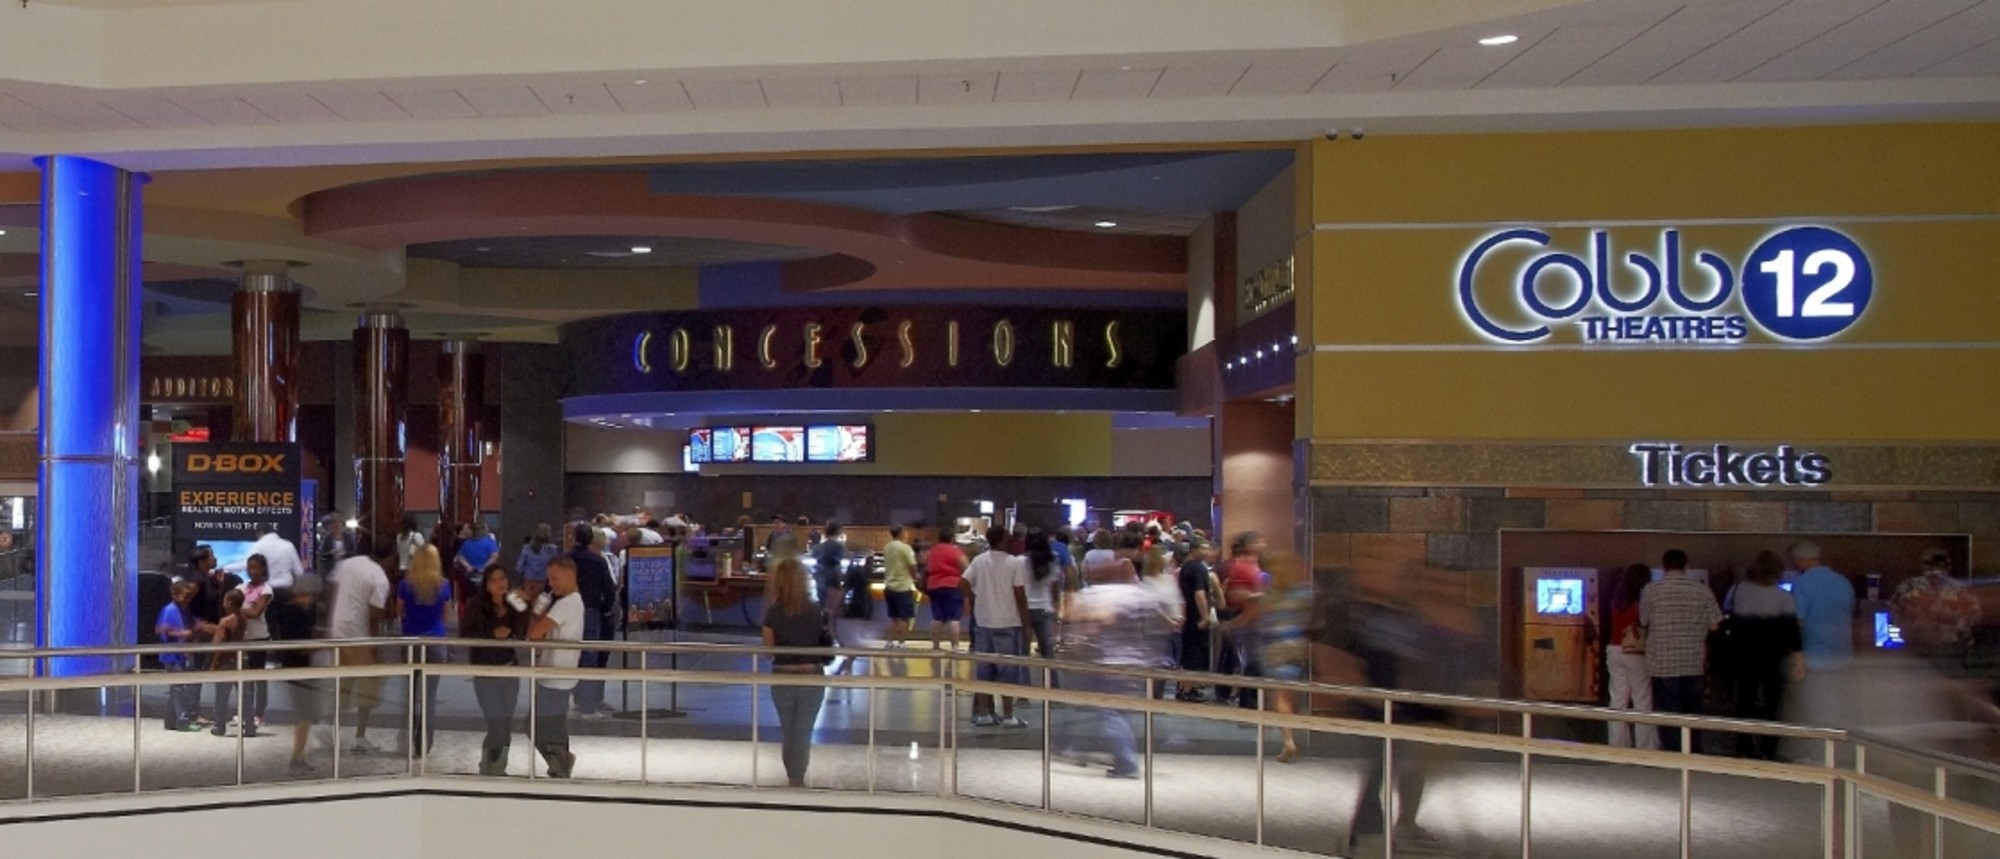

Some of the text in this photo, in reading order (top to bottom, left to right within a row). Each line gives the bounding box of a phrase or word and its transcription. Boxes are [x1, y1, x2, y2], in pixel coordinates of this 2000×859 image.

[1459, 228, 1856, 341] Cobb 12
[1579, 316, 1748, 341] THEATRES
[633, 319, 1122, 373] CONCESSIONS
[187, 454, 286, 472] D-BOX
[1631, 443, 1833, 486] Tickets
[180, 491, 294, 506] EXPERIENCE
[182, 506, 293, 515] REALISTIC MOTION EFFECTS
